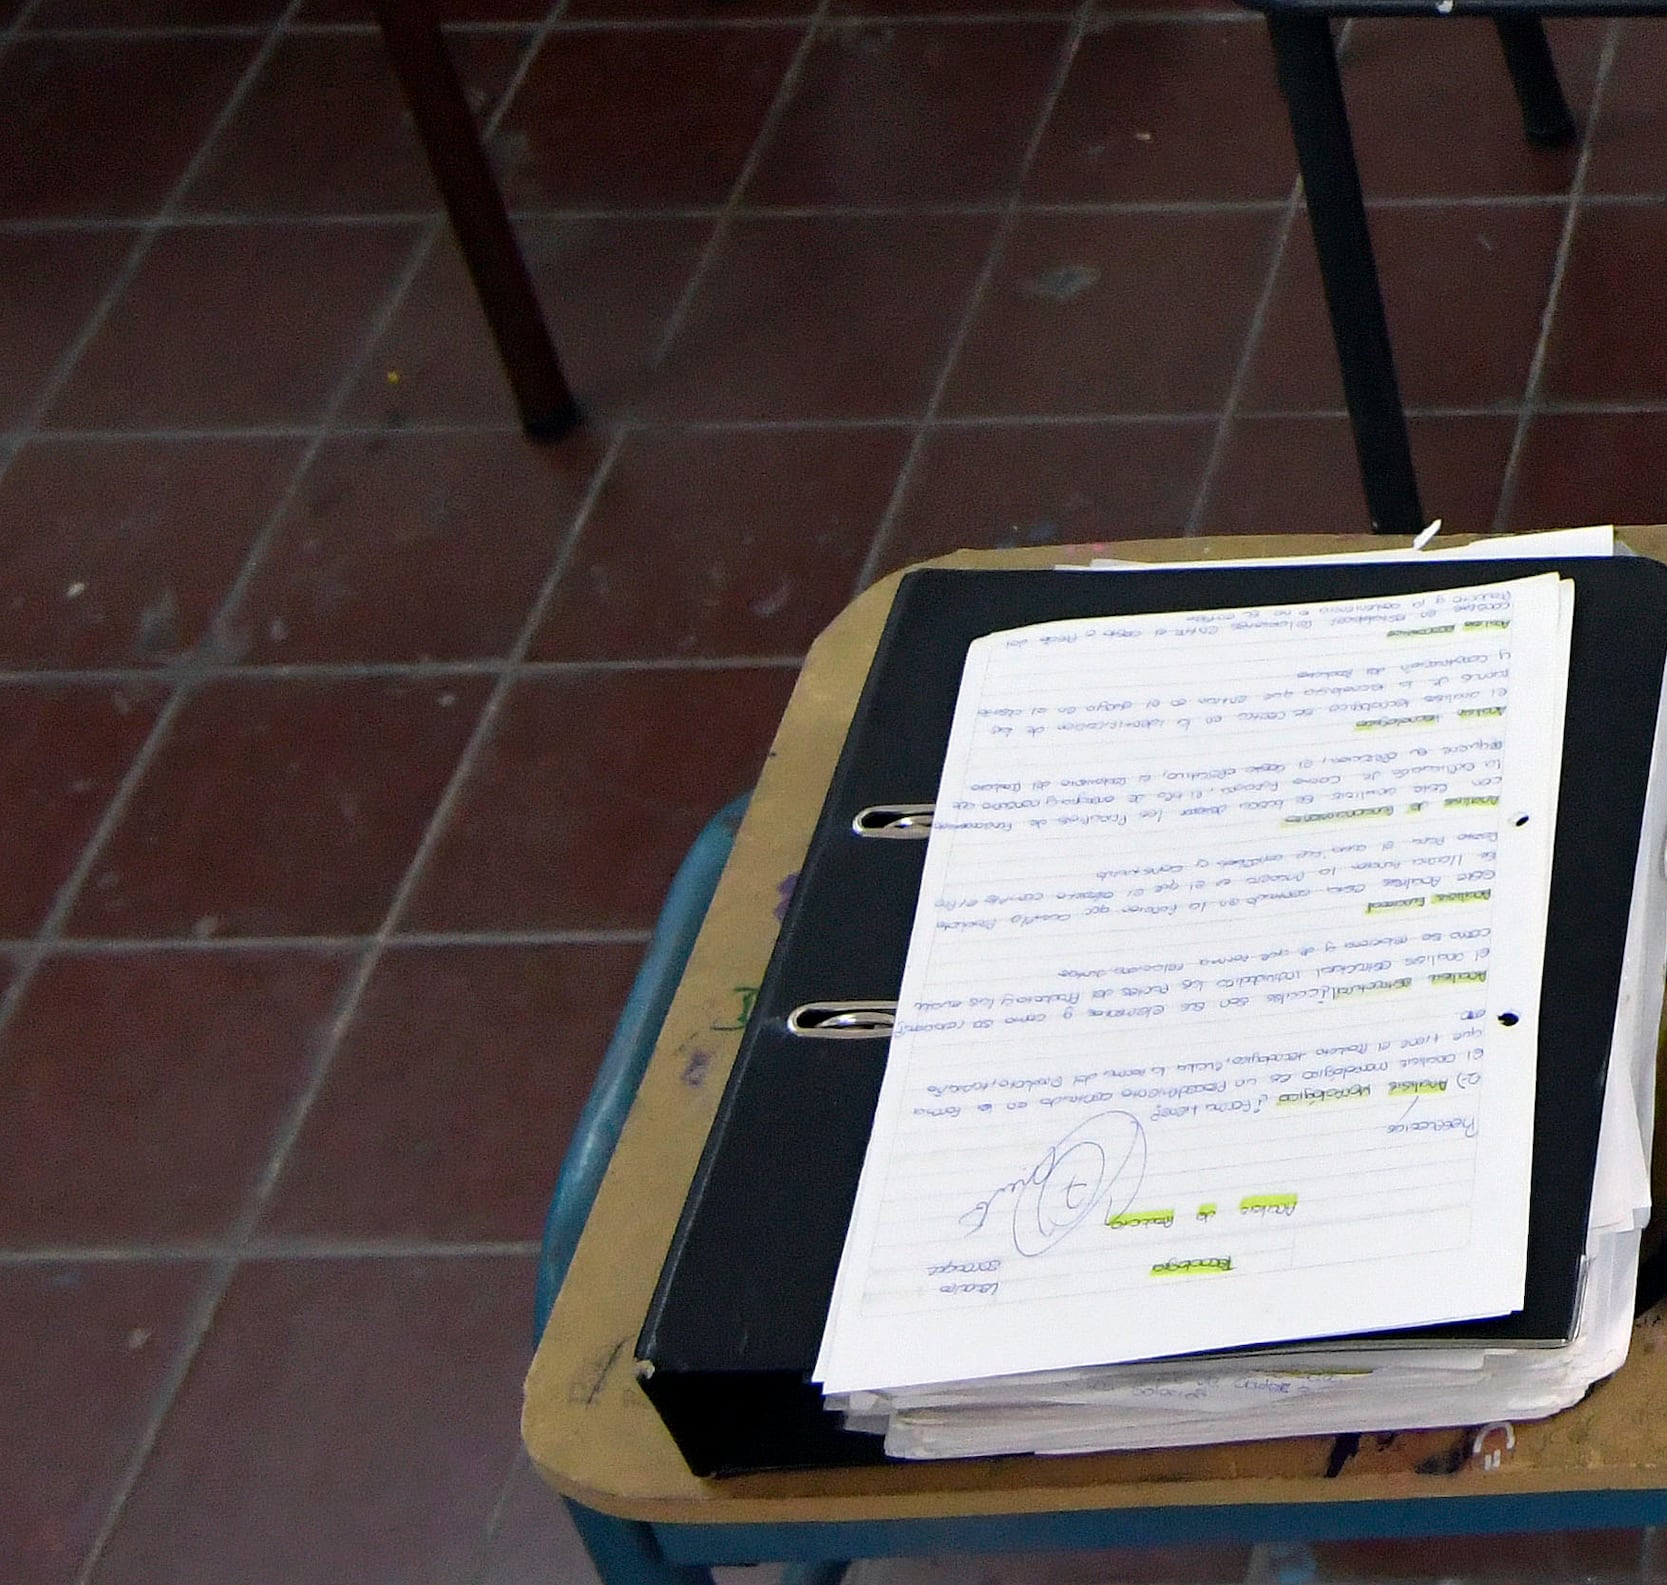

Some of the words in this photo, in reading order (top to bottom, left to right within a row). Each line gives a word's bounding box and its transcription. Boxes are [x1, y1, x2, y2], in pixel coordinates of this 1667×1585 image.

[1497, 649, 1512, 660] y
[1204, 714, 1223, 724] en
[1154, 878, 1179, 893] que
[1449, 926, 1491, 939] como
[1324, 940, 1337, 952] y
[1259, 948, 1289, 961] que
[1218, 995, 1249, 1008] son
[1003, 1013, 1046, 1024] como
[1061, 1005, 1073, 1020] y
[1452, 1026, 1483, 1041] que
[1234, 1077, 1257, 1088] un
[1005, 1100, 1028, 1110] en
